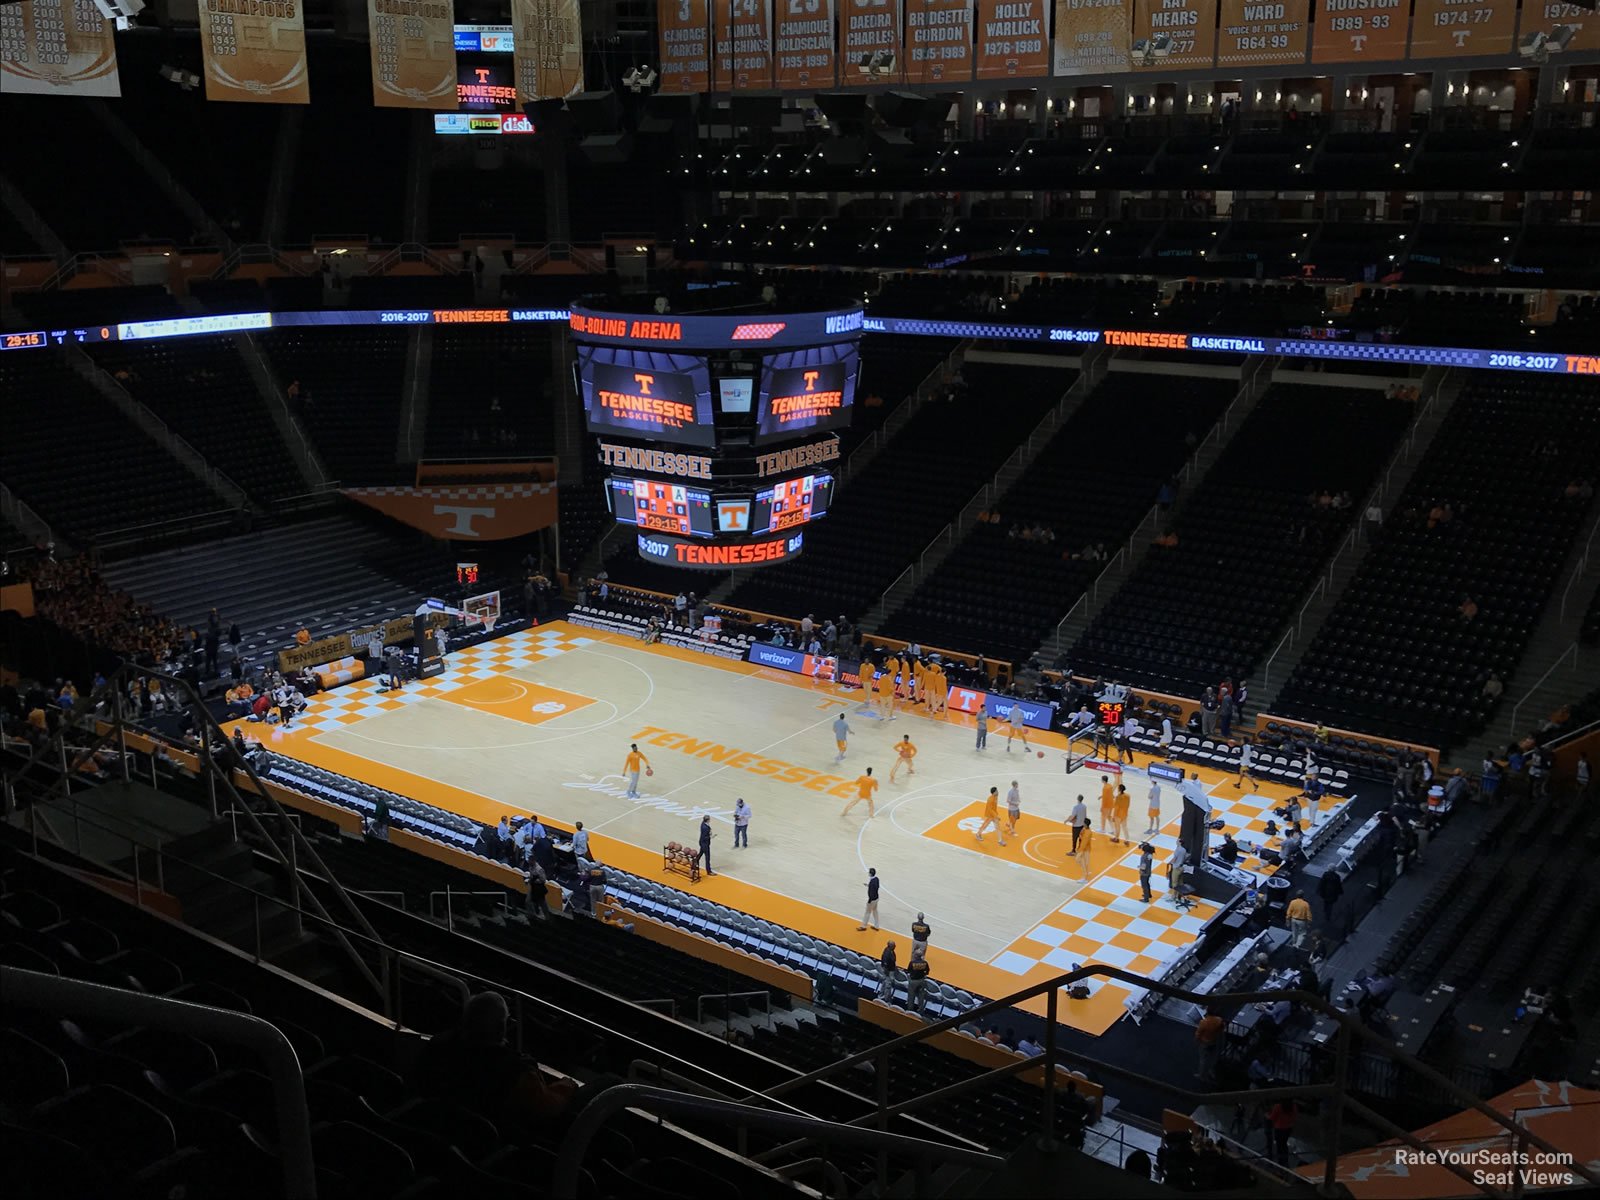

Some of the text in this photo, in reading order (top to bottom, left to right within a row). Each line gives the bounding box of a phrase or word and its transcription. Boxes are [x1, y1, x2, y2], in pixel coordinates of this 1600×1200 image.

[995, 3, 1032, 19] HOLLY
[1152, 11, 1198, 27] MEARS
[1244, 4, 1284, 21] WARD
[1434, 9, 1493, 26] 1974-77
[780, 20, 830, 35] CHAMIQUE
[850, 13, 891, 30] DAEDRA
[986, 20, 1041, 37] WARLICK
[1331, 15, 1391, 31] 1989-93
[847, 31, 895, 46] CHARLES
[914, 27, 963, 42] GORDON
[1171, 30, 1195, 38] COACH
[1452, 30, 1471, 47] T
[777, 36, 832, 51] HOLDSCLAW
[984, 40, 1042, 56] 1976-1980
[1236, 35, 1288, 50] 1964-99
[1350, 35, 1367, 52] T
[780, 55, 829, 68] 1995-1999
[1059, 56, 1128, 69] CHAMPIONSHIPS
[503, 117, 534, 132] dish
[382, 312, 429, 322] 2016-2017
[433, 310, 510, 323] TENNESSEE
[100, 327, 109, 340] 0
[126, 325, 136, 338] A
[630, 320, 682, 341] ARENA
[6, 334, 40, 347] 29:15
[1049, 328, 1266, 353] 2016-2017 TENNESSEE BASKETBALL
[1489, 353, 1559, 370] 2016-2017
[634, 373, 655, 395] T
[803, 370, 819, 391] T
[598, 390, 694, 424] TENNESSEE
[771, 391, 842, 416] TENNESSEE
[612, 409, 683, 429] BASKETBALL
[779, 407, 832, 423] BASKETBALL
[600, 442, 713, 480] TENNESSEE
[756, 437, 841, 478] TENNESSEE
[675, 489, 684, 501] A
[433, 505, 496, 537] T
[648, 515, 679, 531] 29:15
[720, 506, 747, 529] T
[779, 511, 803, 527] 29:15
[673, 540, 786, 565] TENNESSEE
[286, 641, 345, 666] TENNESSEE
[759, 651, 791, 666] verizon
[959, 689, 977, 710] T
[994, 703, 1034, 721] veron
[1103, 710, 1119, 724] 30
[630, 725, 861, 800] TENNESSEE
